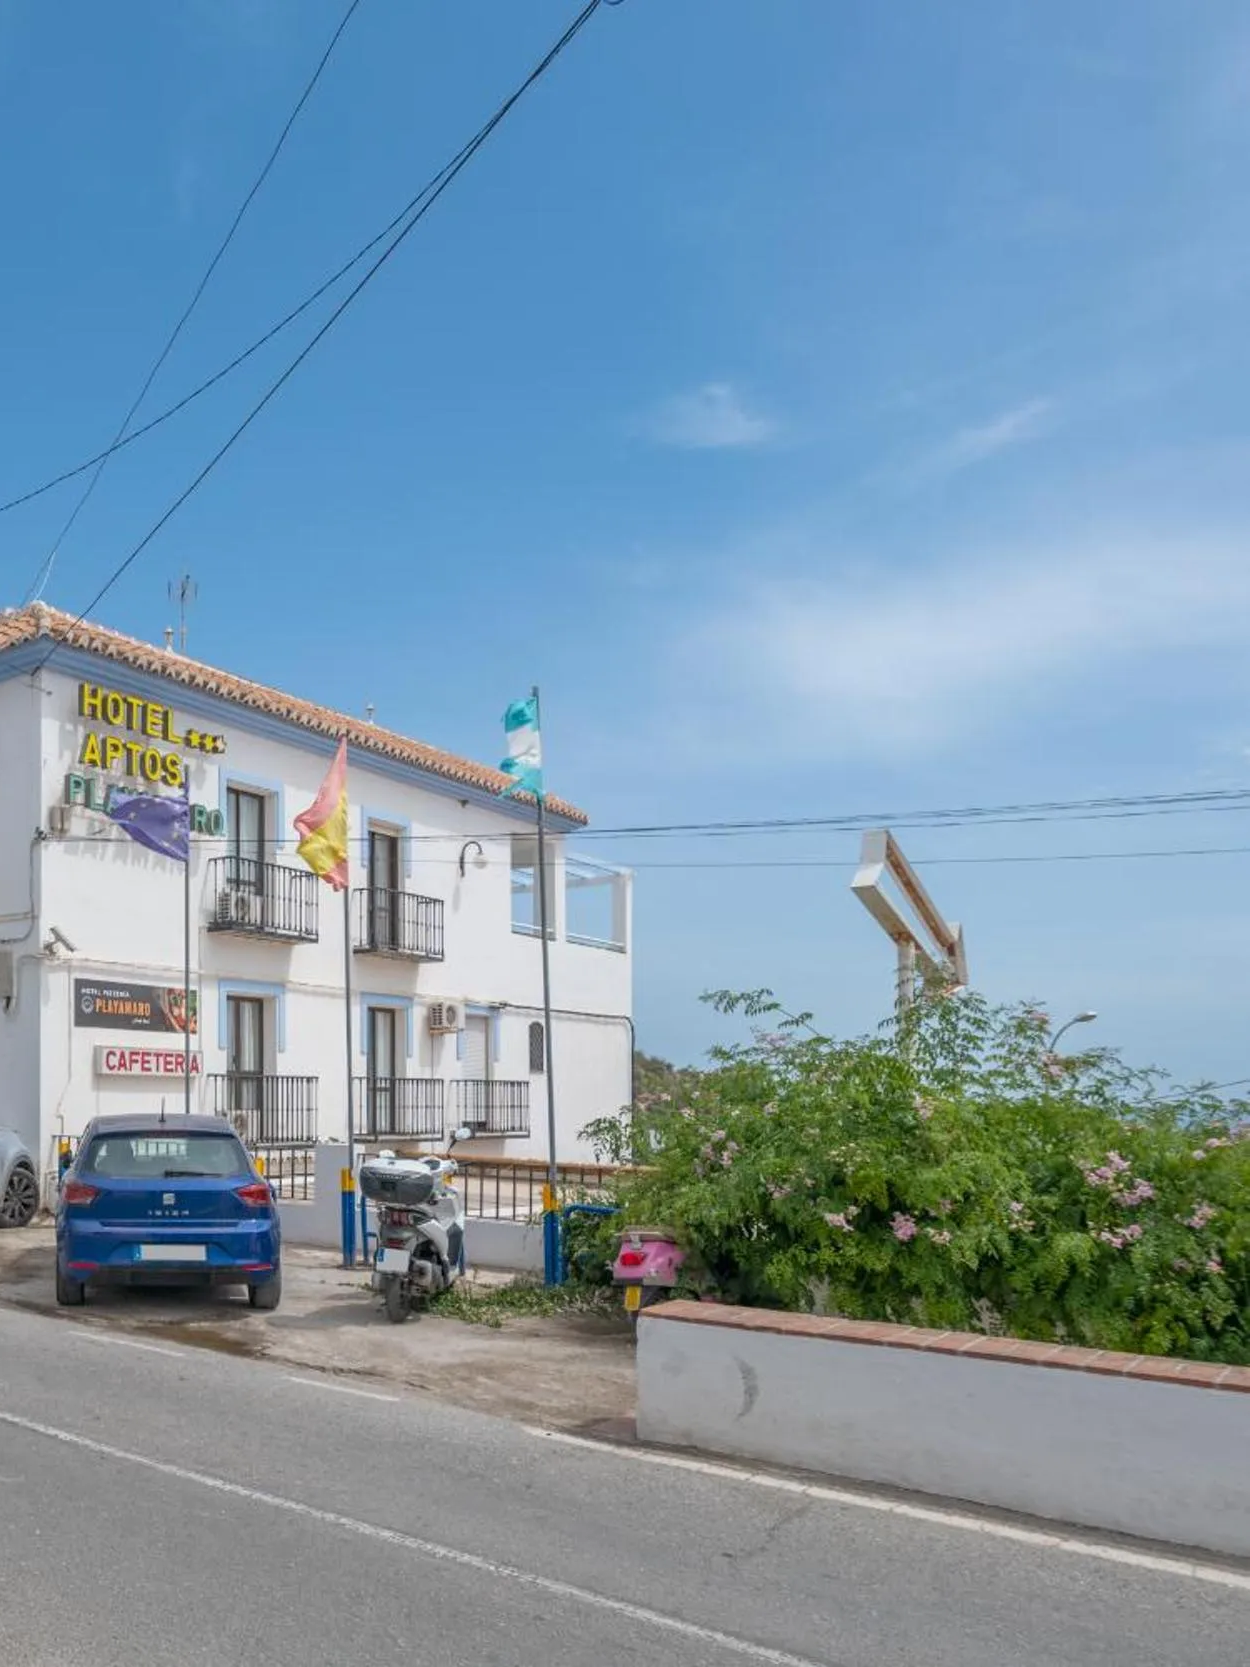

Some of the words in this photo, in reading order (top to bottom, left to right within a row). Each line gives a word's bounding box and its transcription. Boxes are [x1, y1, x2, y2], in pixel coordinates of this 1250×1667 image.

[79, 681, 183, 744] HOTEL
[81, 732, 183, 788] APTOS
[105, 1050, 200, 1074] CAFETERA
